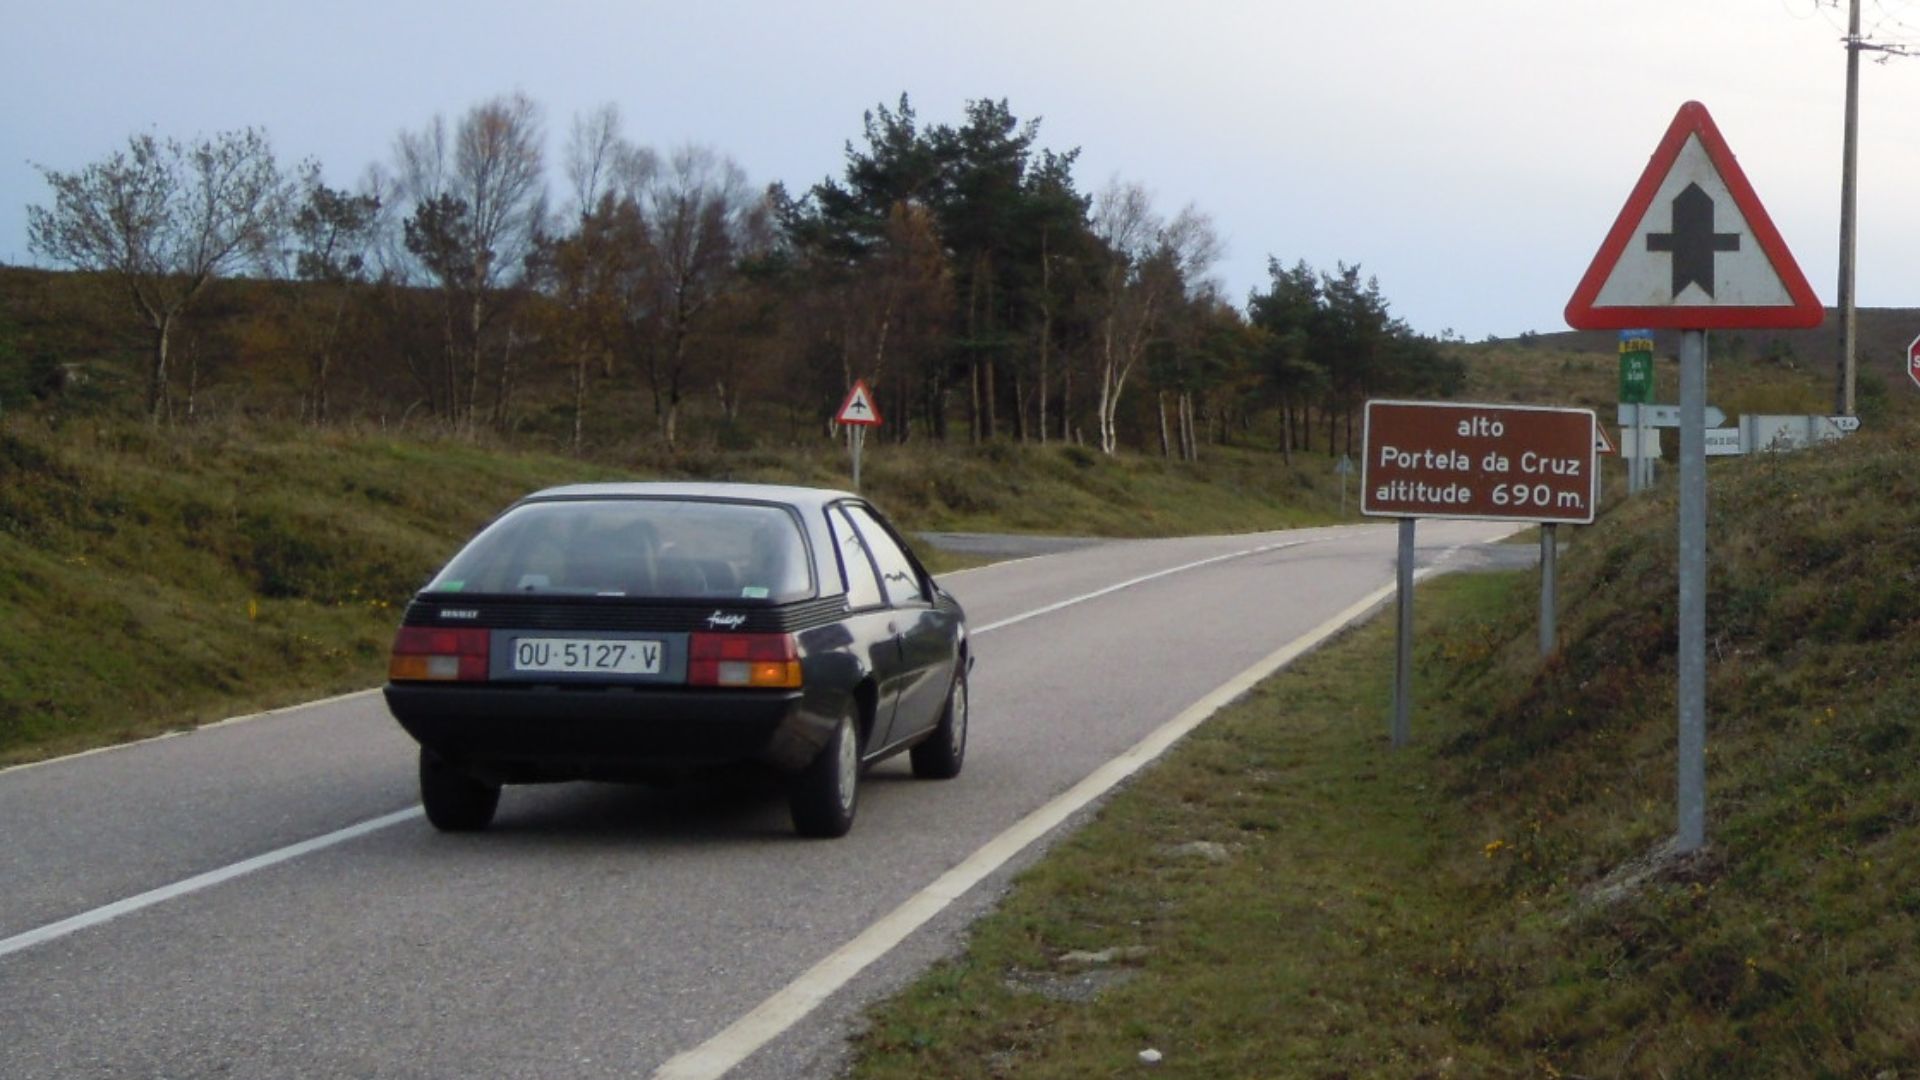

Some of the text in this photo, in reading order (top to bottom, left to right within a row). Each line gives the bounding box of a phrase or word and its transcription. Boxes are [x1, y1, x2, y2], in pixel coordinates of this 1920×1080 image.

[1457, 416, 1504, 437] alto
[1380, 446, 1581, 476] Portela da Cruz
[1376, 480, 1472, 504] altitude
[1492, 483, 1551, 506] 690
